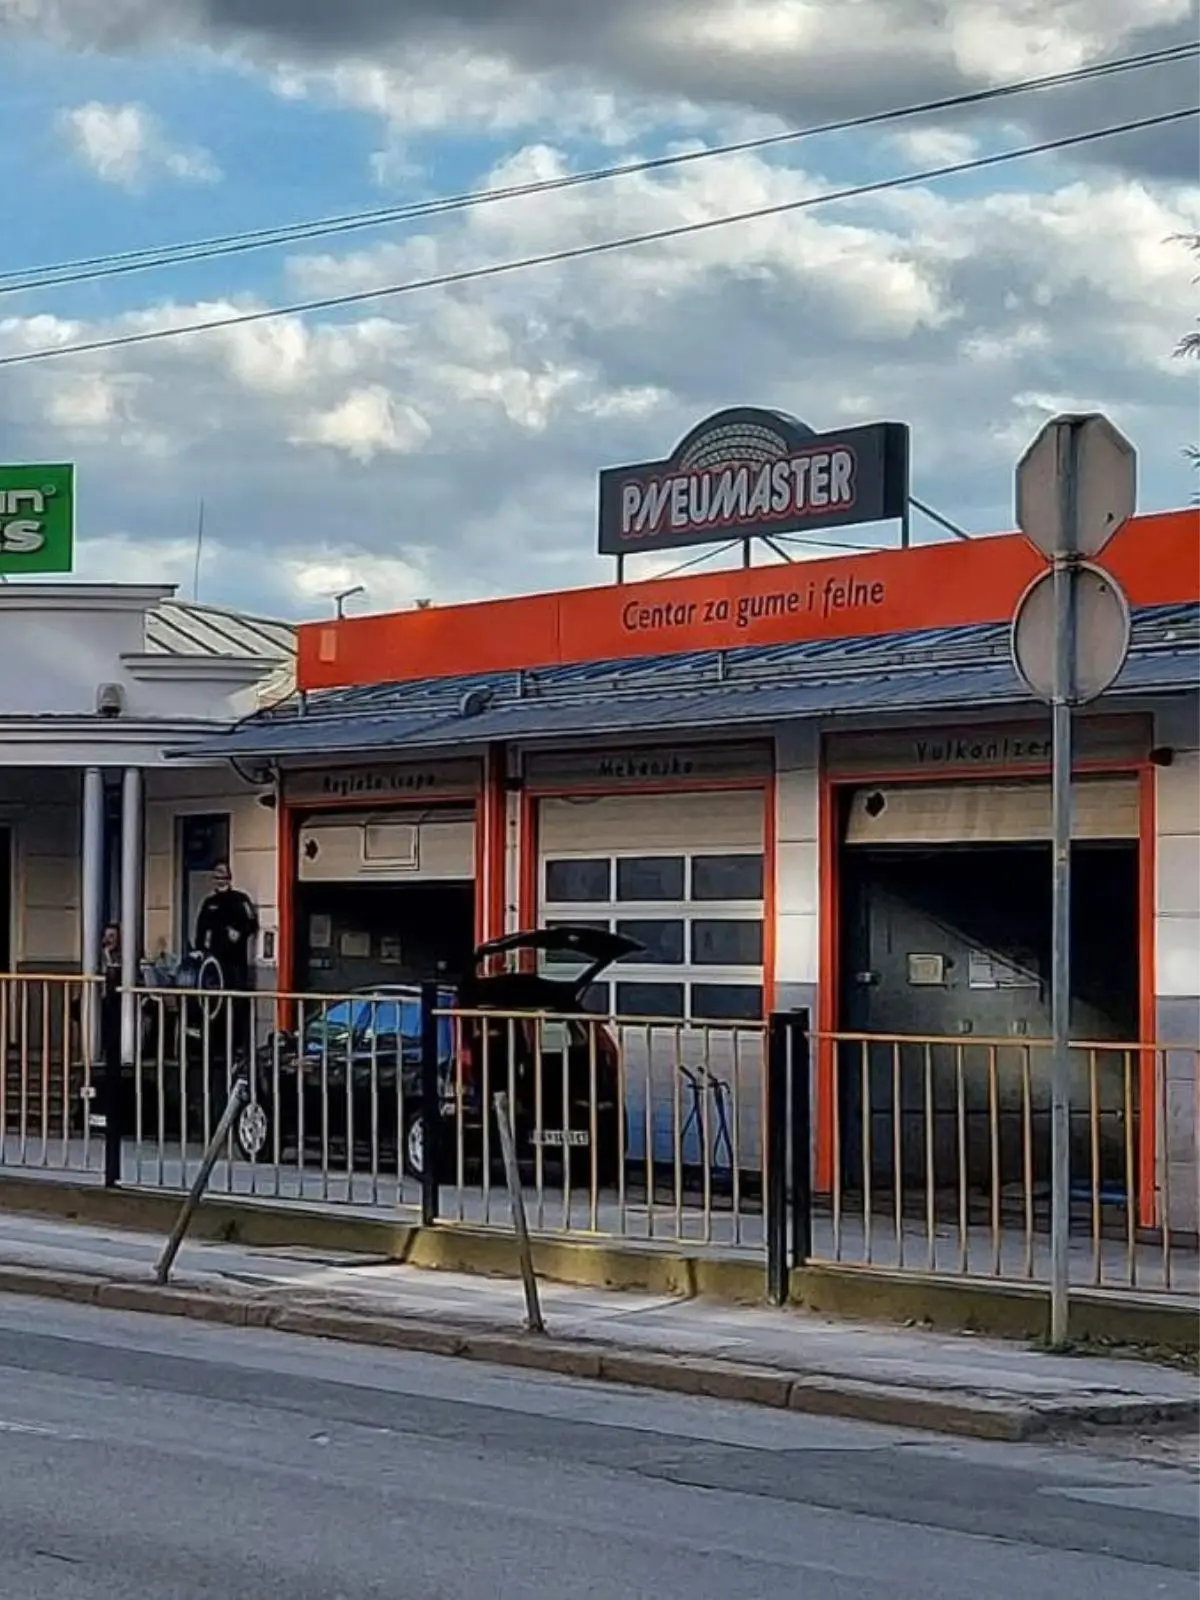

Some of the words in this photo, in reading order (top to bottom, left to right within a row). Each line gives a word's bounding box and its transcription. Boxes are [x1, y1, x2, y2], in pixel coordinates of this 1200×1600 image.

[621, 449, 852, 534] PNEUMASTER
[622, 600, 697, 631] Centar
[703, 599, 729, 623] za
[736, 590, 800, 628] gume
[808, 581, 814, 611] i
[823, 573, 885, 618] felne
